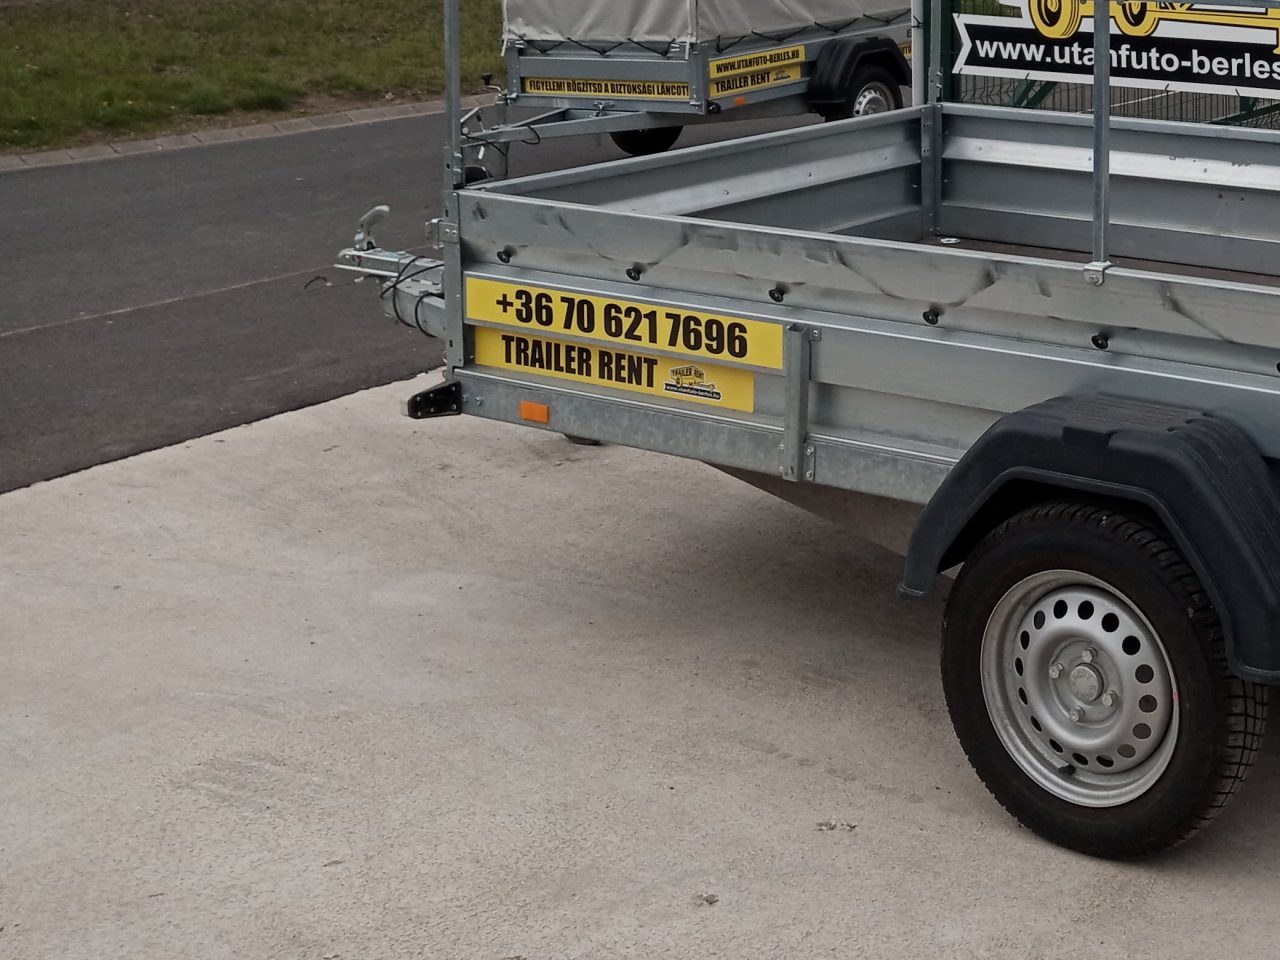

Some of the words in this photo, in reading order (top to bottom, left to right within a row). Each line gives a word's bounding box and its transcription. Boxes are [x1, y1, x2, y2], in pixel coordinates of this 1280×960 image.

[716, 49, 800, 74] WWW.UTANFUTO-BERLES.HU
[529, 79, 566, 91] FIGYELEM!
[604, 83, 610, 94] A
[715, 76, 749, 93] TRAILER
[750, 71, 771, 86] RENT
[495, 289, 554, 327] +36
[560, 295, 595, 333] 70
[603, 302, 658, 344] 621
[664, 312, 748, 358] 7696
[501, 334, 592, 378] TRAILER
[598, 349, 658, 389] RENT
